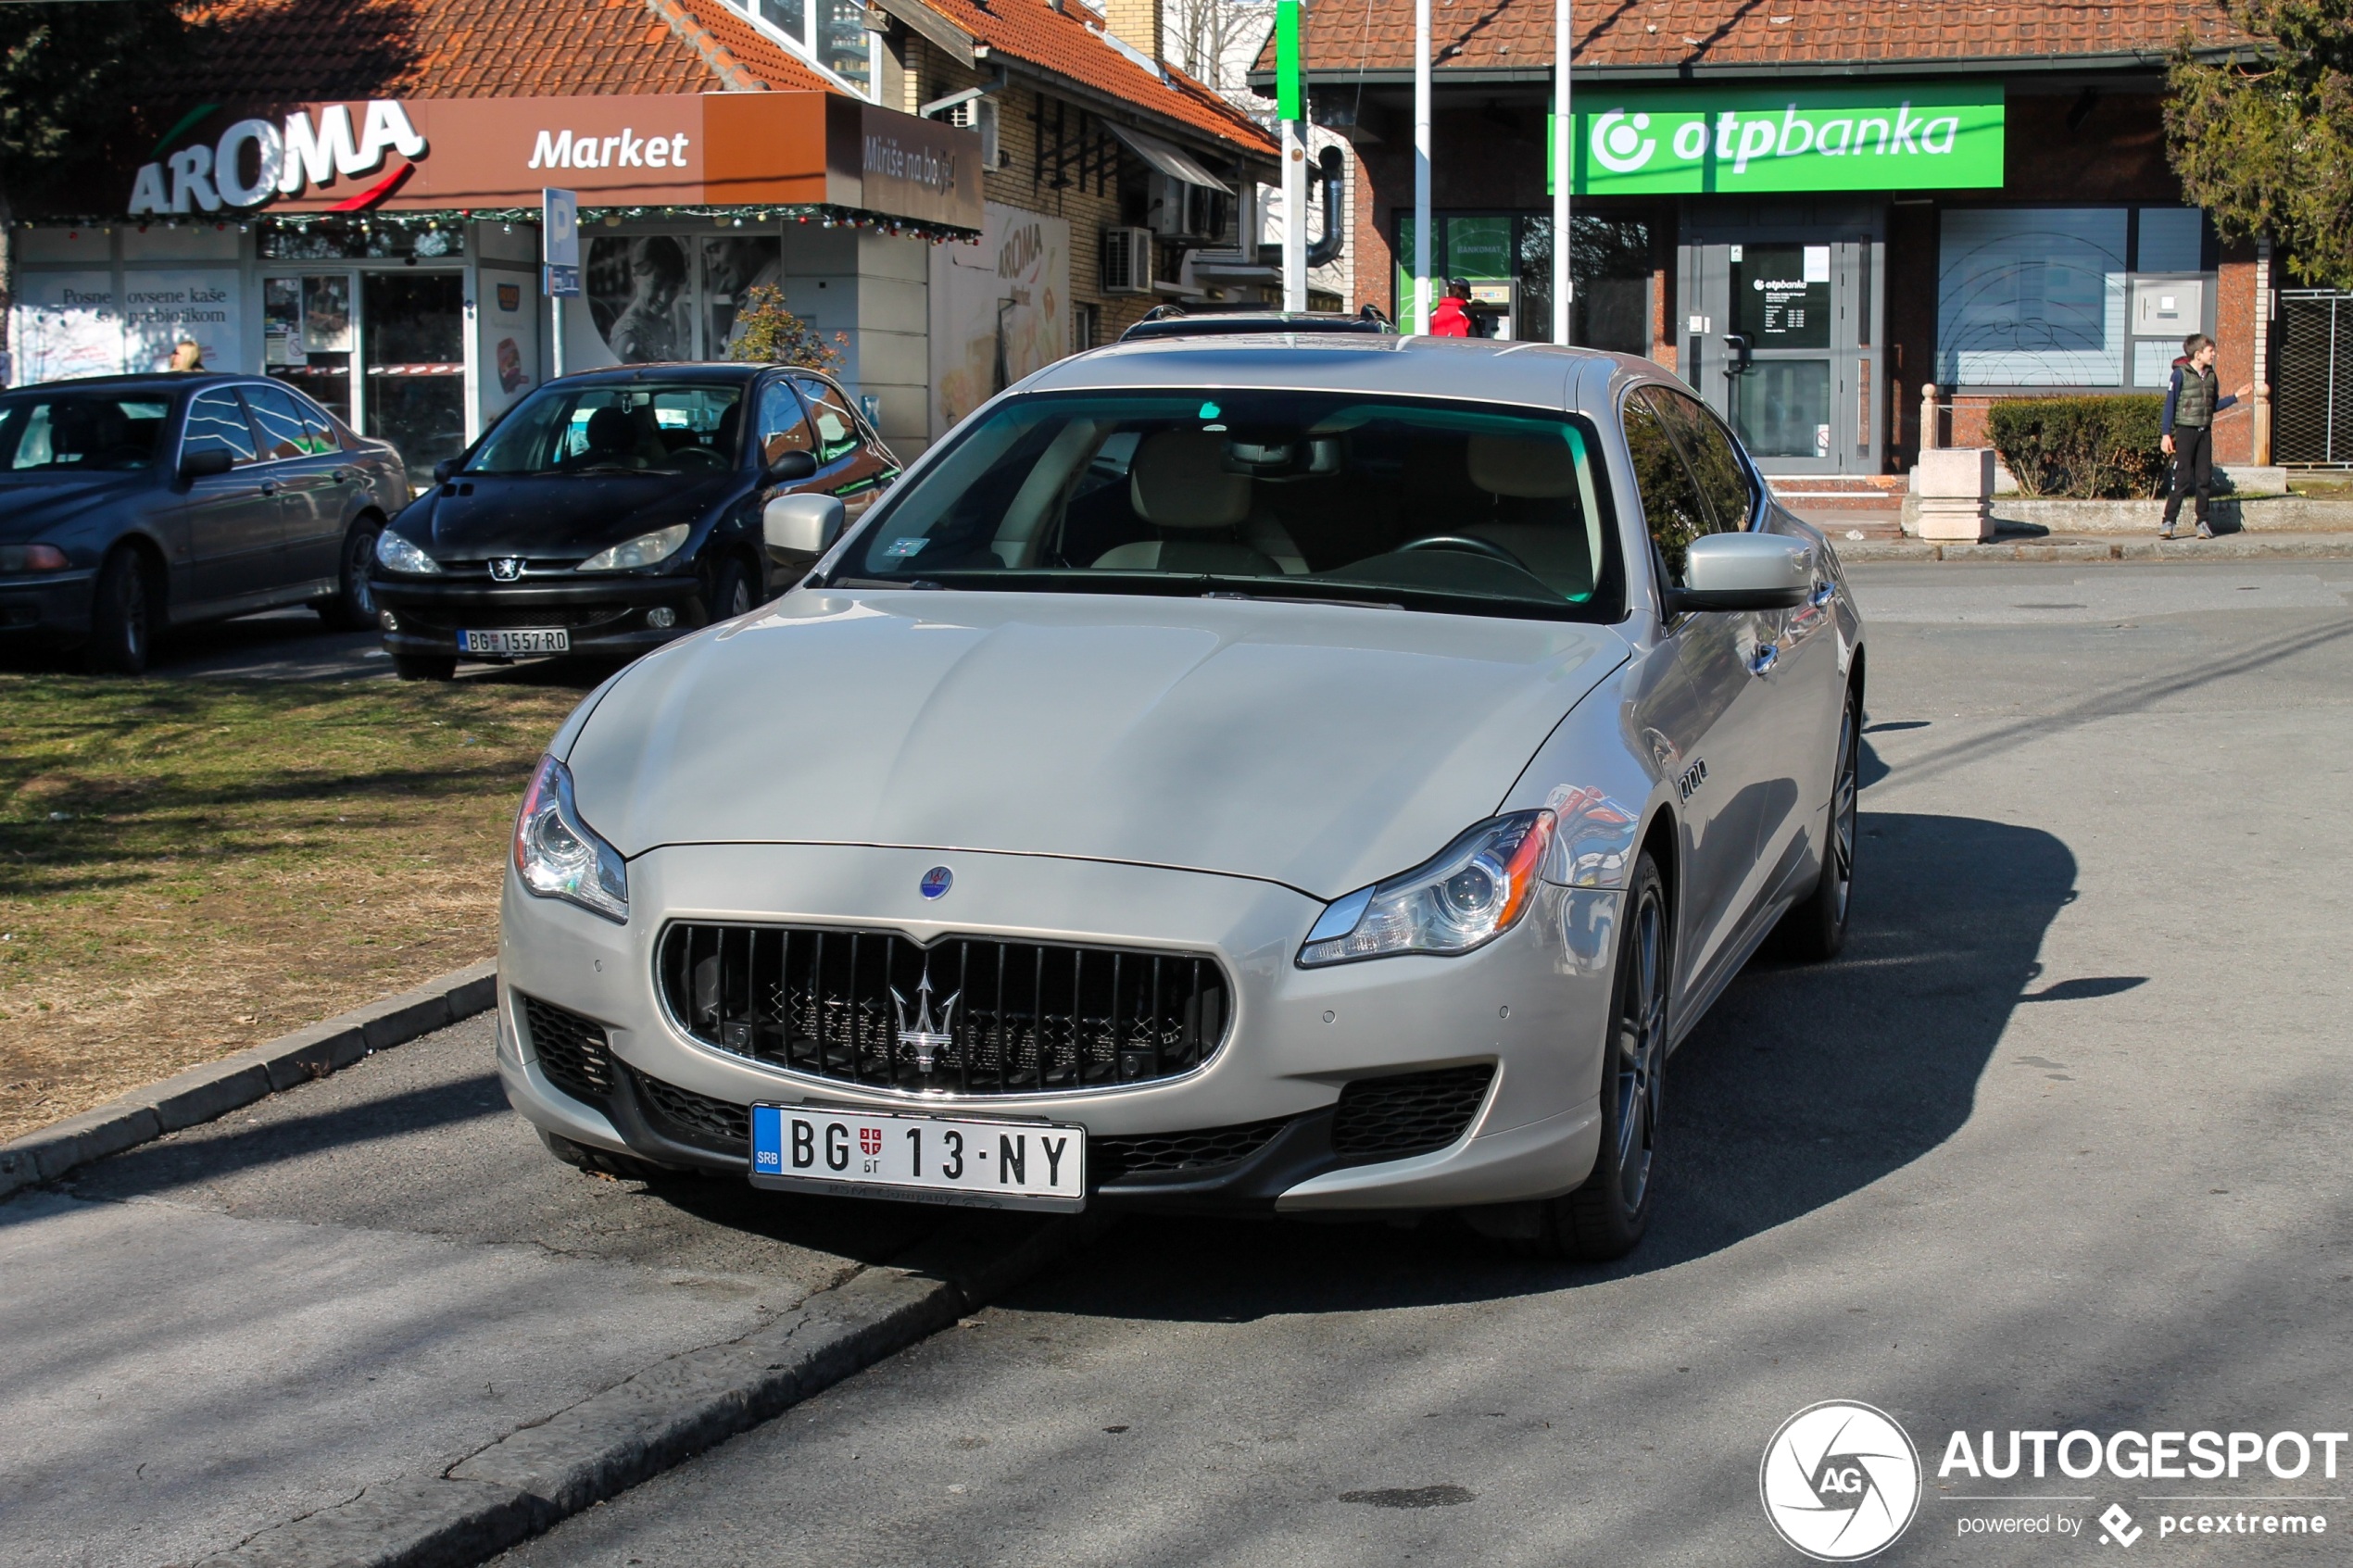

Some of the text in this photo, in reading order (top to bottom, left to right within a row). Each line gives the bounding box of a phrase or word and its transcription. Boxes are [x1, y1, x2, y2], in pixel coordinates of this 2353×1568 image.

[128, 99, 427, 214] AROMA
[527, 127, 690, 169] Market
[863, 134, 904, 179] Miriše
[906, 151, 923, 182] na
[1672, 100, 1959, 175] otpbanka
[552, 197, 571, 255] P
[998, 222, 1043, 279] AROMA
[1457, 245, 1502, 254] BANKOMAT
[63, 287, 227, 304] Posne ovsene kaše
[1765, 279, 1807, 291] otpbanka
[128, 307, 226, 327] prebiotikom
[469, 633, 489, 650] BG
[757, 1151, 778, 1165] SRB
[791, 1118, 849, 1172] BG
